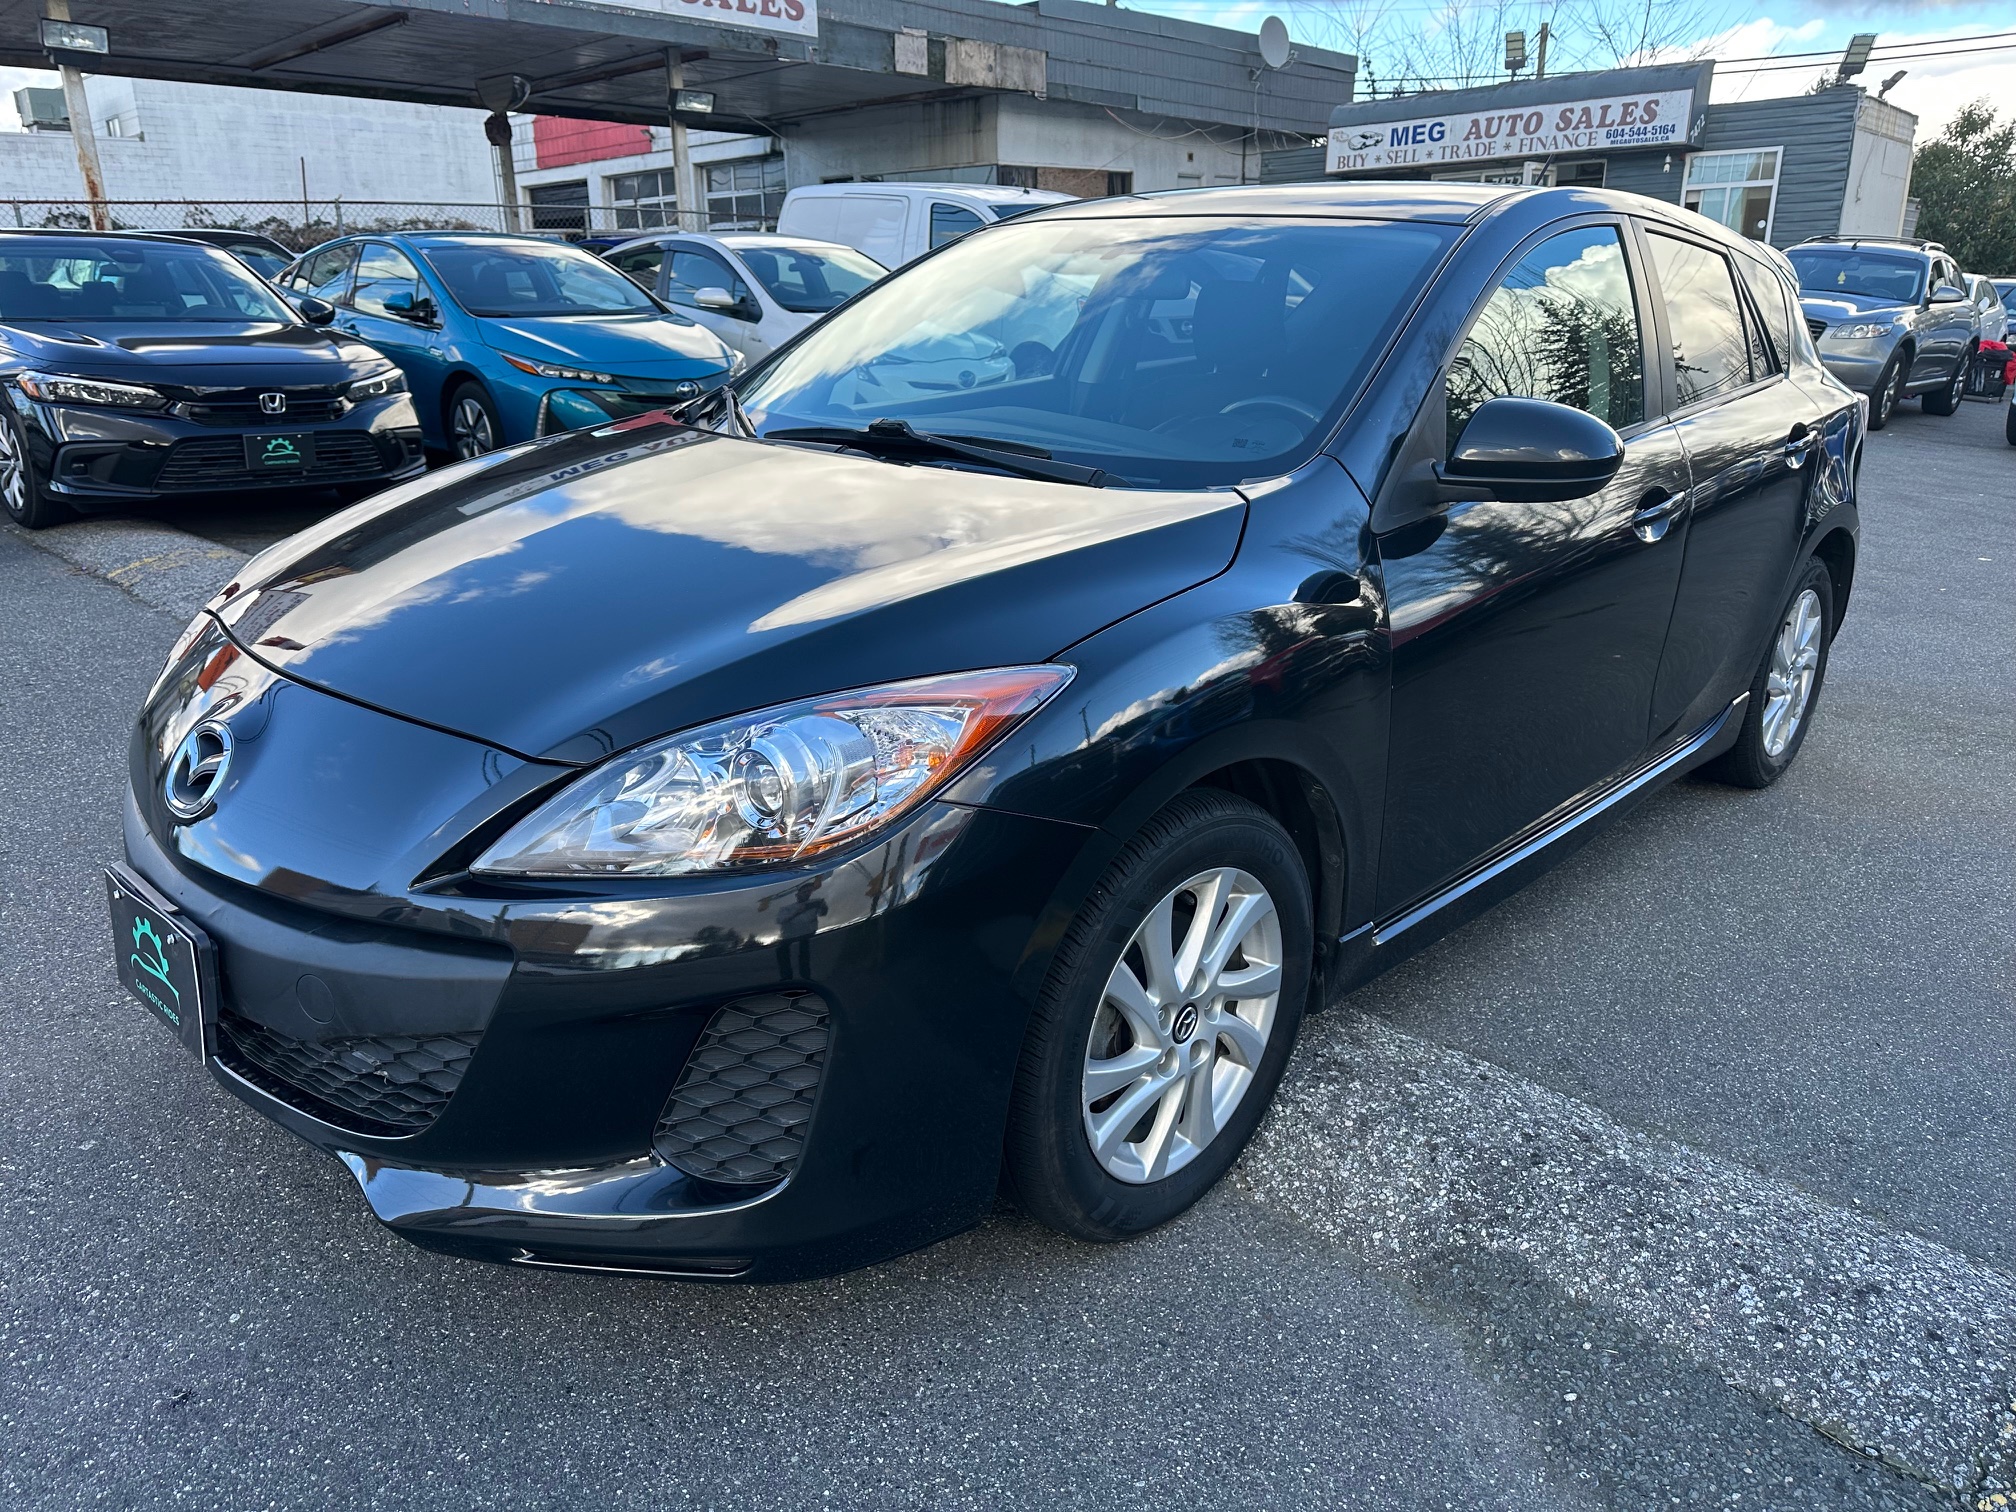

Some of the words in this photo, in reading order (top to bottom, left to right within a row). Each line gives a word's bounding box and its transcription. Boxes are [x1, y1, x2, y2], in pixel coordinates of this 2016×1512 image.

[682, 0, 805, 21] LES
[1389, 121, 1446, 148] MEG
[1462, 111, 1544, 141] AUTO
[1555, 99, 1660, 132] SALES
[1605, 123, 1676, 139] 604-544-5164
[1336, 152, 1369, 170] BUY
[1386, 149, 1420, 165] SELL
[1439, 140, 1497, 160] TRADE
[1518, 130, 1599, 153] FINANCE
[1609, 135, 1670, 146] MEGAUTOSALES.CA
[135, 978, 163, 1011] CARTASTIC
[163, 1004, 180, 1026] RIDES
